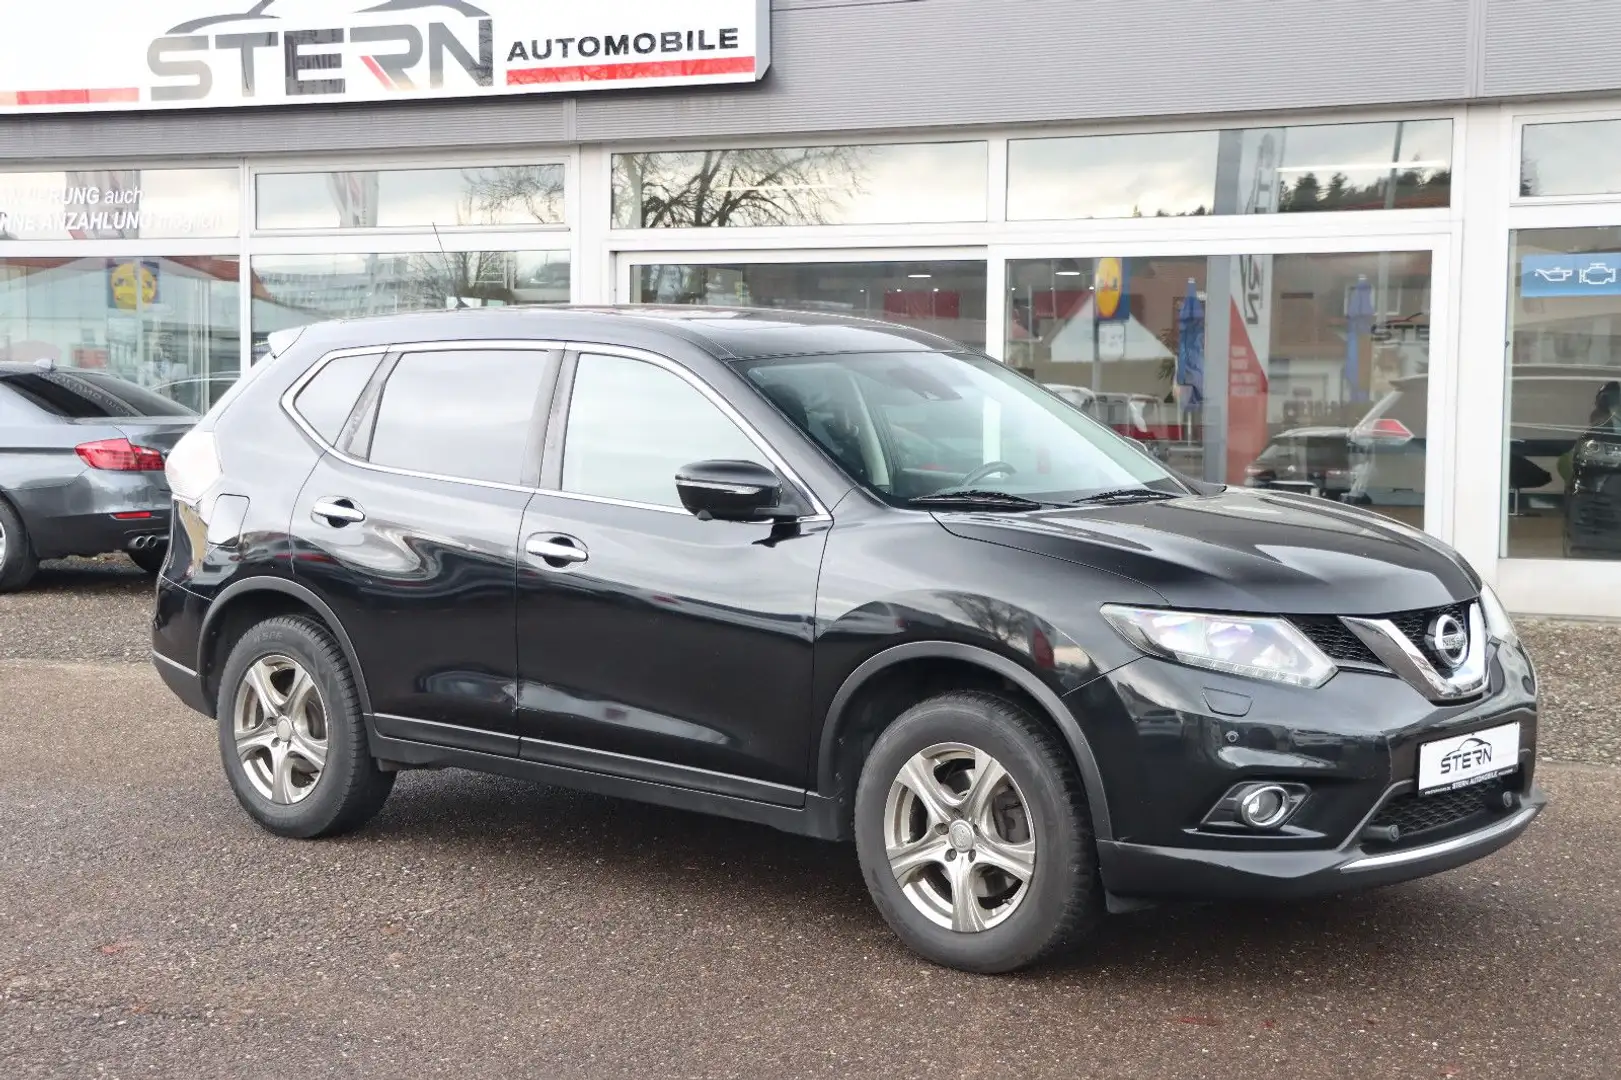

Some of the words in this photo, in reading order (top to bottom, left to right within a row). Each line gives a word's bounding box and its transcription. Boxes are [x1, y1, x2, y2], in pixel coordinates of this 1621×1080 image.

[147, 20, 493, 101] STERN
[507, 28, 738, 61] AUTOMOBILE
[104, 187, 143, 205] auch
[42, 211, 151, 231] ANZAHLUNG
[1441, 748, 1492, 774] STERN
